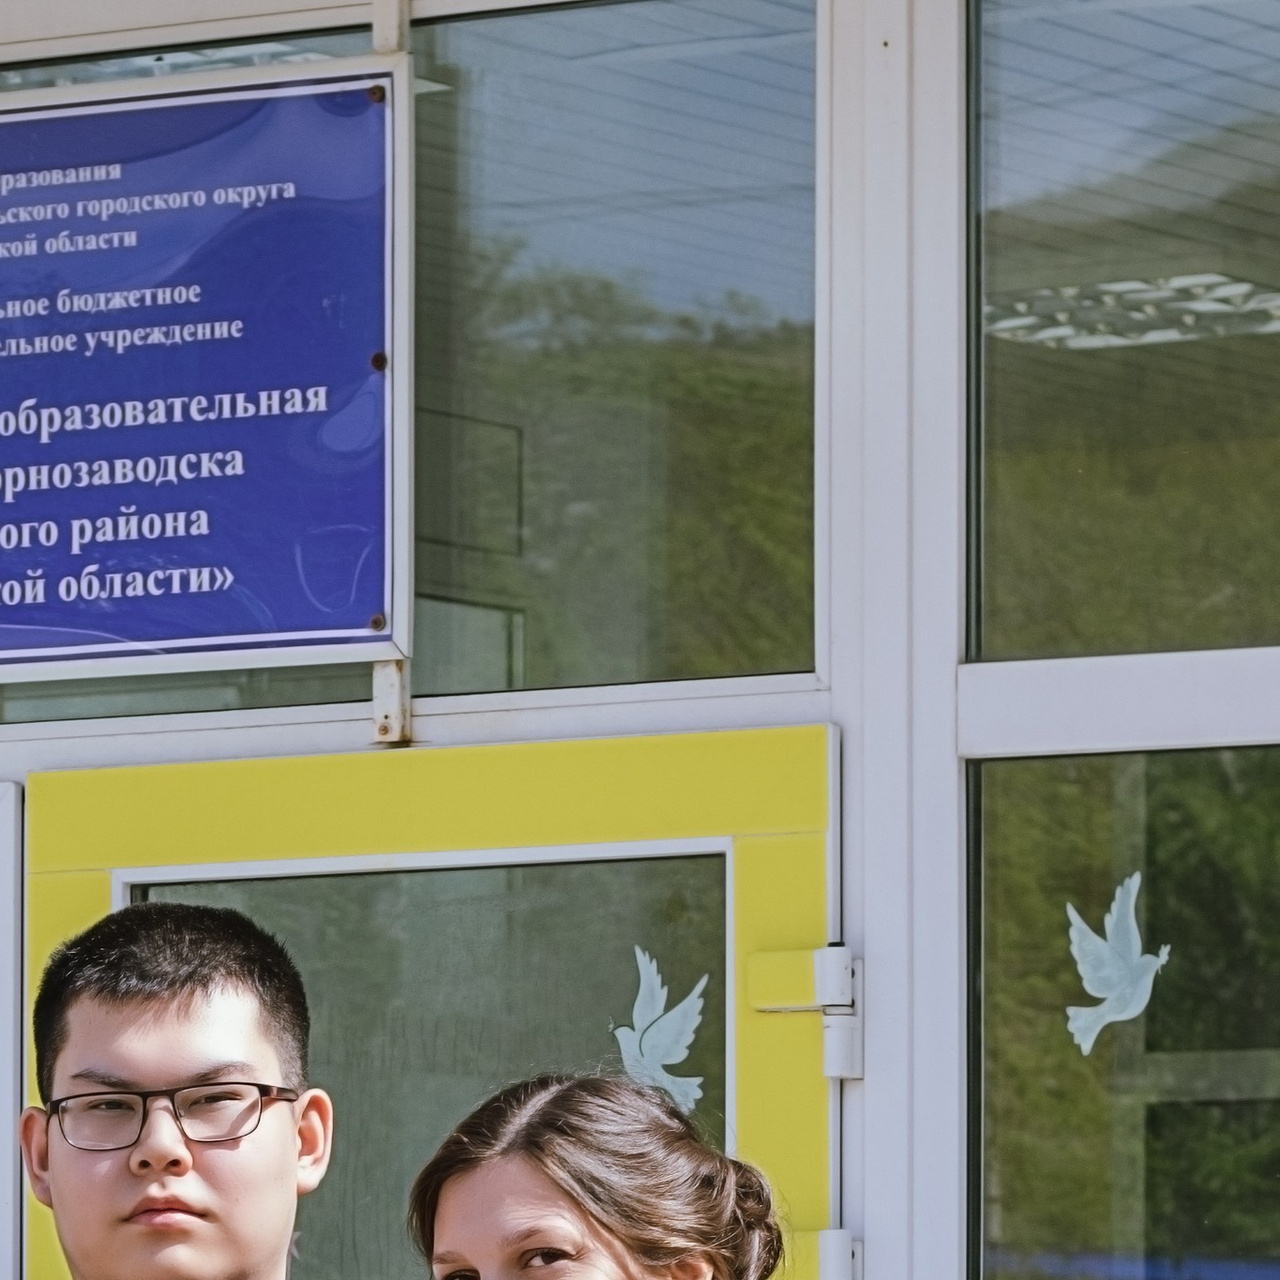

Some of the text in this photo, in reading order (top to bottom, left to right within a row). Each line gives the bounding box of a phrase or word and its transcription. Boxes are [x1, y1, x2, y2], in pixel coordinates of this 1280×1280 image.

[76, 189, 208, 220] городского
[212, 181, 297, 211] округа
[44, 229, 138, 257] области
[56, 283, 203, 314] бюджетное
[83, 315, 245, 355] учреждение
[70, 504, 210, 553] района
[58, 563, 235, 603] области»
